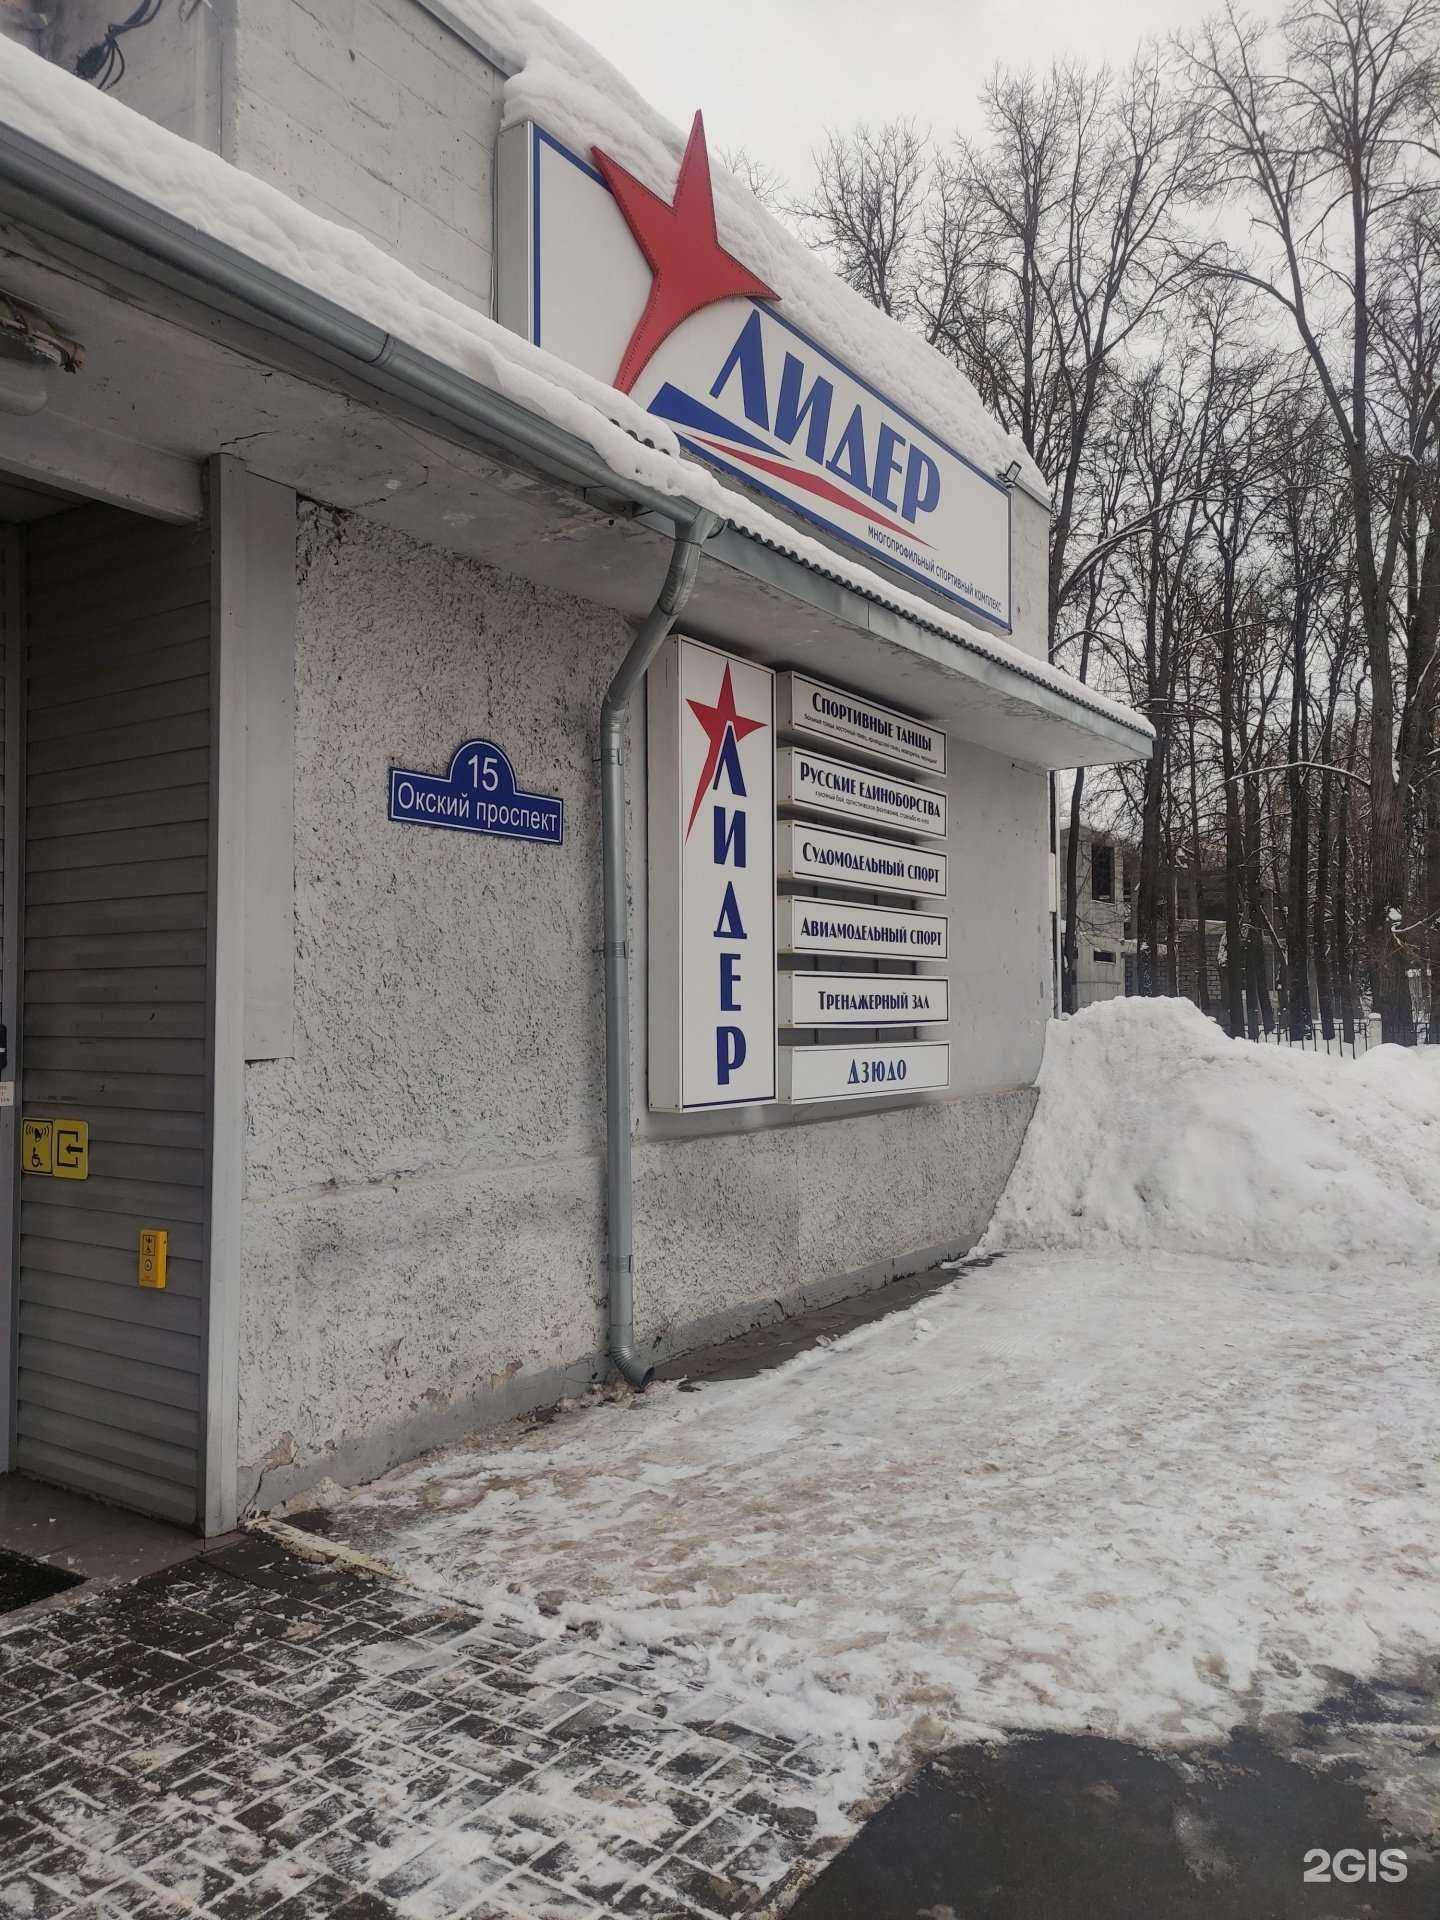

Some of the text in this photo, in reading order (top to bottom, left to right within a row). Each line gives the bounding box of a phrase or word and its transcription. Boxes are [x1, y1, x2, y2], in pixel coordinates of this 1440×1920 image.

[709, 309, 940, 524] ЛИДЕР
[868, 525, 1003, 612] МНОГОПРОФИЛЬНЫЙ СПОРТИВНЫЙ КОМПЛЕКС
[398, 782, 558, 829] Окский проспект
[467, 754, 499, 791] 15
[712, 725, 747, 1085] ЛИДЕР
